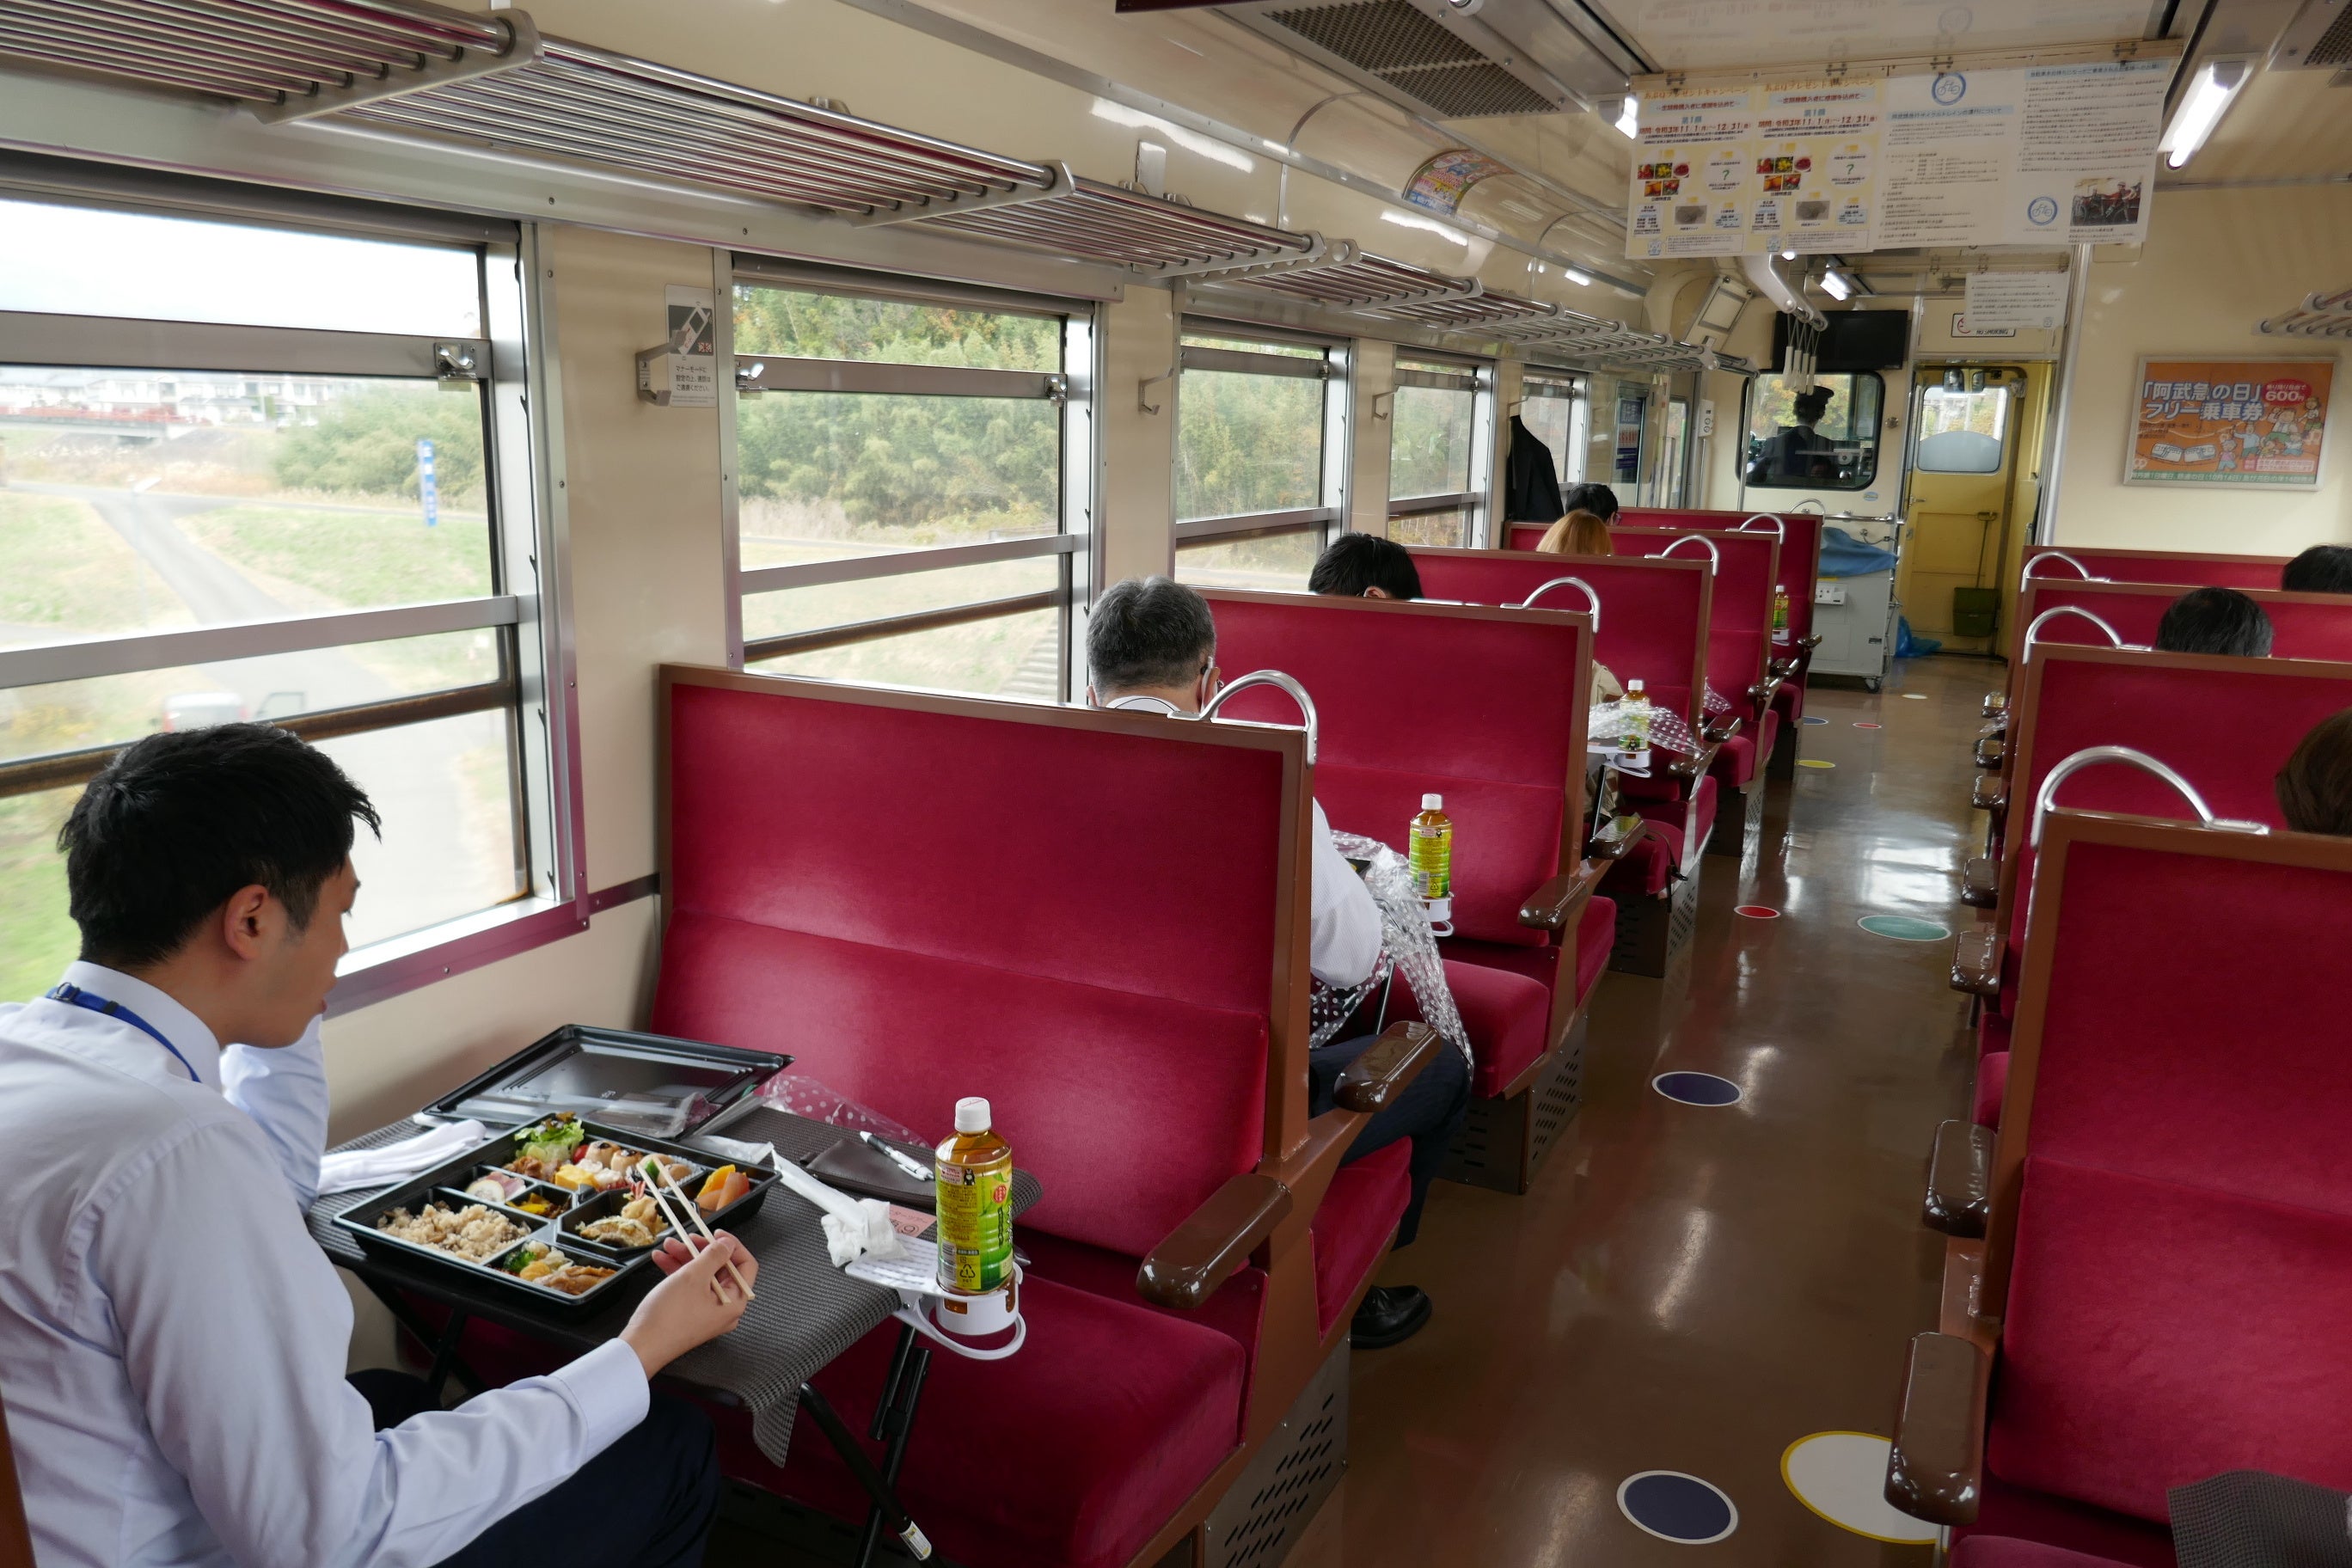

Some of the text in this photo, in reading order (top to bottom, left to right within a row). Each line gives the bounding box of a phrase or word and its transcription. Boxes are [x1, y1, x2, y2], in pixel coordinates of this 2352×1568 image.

[676, 383, 710, 392] ご遠慮ください。
[2143, 382, 2263, 401] 「阿武急の日」
[2264, 390, 2305, 402] 600円
[2146, 401, 2264, 421] フリー乗車券
